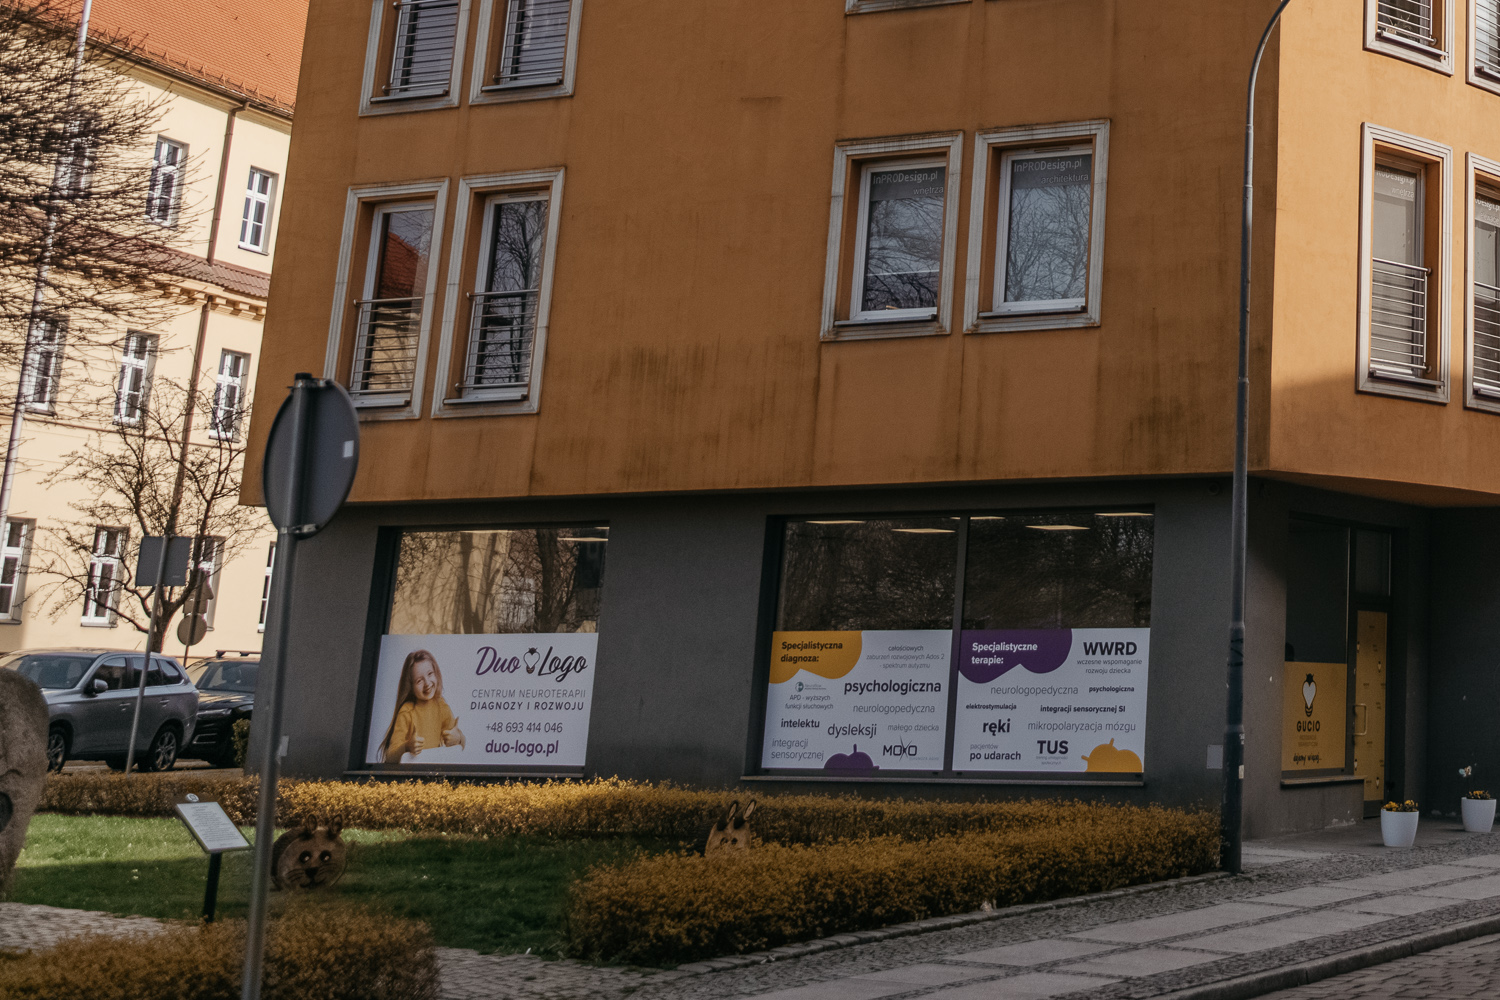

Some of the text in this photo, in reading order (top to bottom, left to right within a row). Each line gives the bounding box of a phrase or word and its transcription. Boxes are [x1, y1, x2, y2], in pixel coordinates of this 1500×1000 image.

[781, 641, 843, 651] Specjalistyczna
[972, 642, 1038, 653] Specjalistyczne
[1083, 642, 1138, 656] WWRD
[475, 646, 588, 683] Duo Logo
[781, 654, 819, 664] diagnoza:
[971, 656, 1004, 666] terapie:
[844, 679, 942, 695] psychologiczna
[990, 685, 1079, 697] neurologopedyczna
[471, 689, 586, 698] CENTRUM NEUROTERAPII
[470, 701, 584, 711] DIAGNOZY I ROZWOJU
[853, 704, 935, 715] neurologopedyczna
[965, 703, 1017, 711] elektrostymulacja
[1040, 705, 1126, 714] integracji sensorycznej SI
[486, 722, 563, 733] +48 693 414 046
[780, 718, 820, 728] intelektu
[887, 724, 939, 732] małego dziecka
[982, 718, 1011, 736] ręki
[1028, 721, 1136, 733] mikropolaryzacja mózgu
[1296, 720, 1320, 732] GUCIO
[827, 723, 877, 739] dysleksji
[485, 739, 559, 757] duo-logo.pl
[771, 738, 809, 749] integracji
[970, 743, 999, 751] pacjentów
[1037, 740, 1069, 755] TUS
[882, 740, 918, 759] MOXO
[771, 750, 825, 761] sensorycznej
[969, 751, 1022, 762] po udarach
